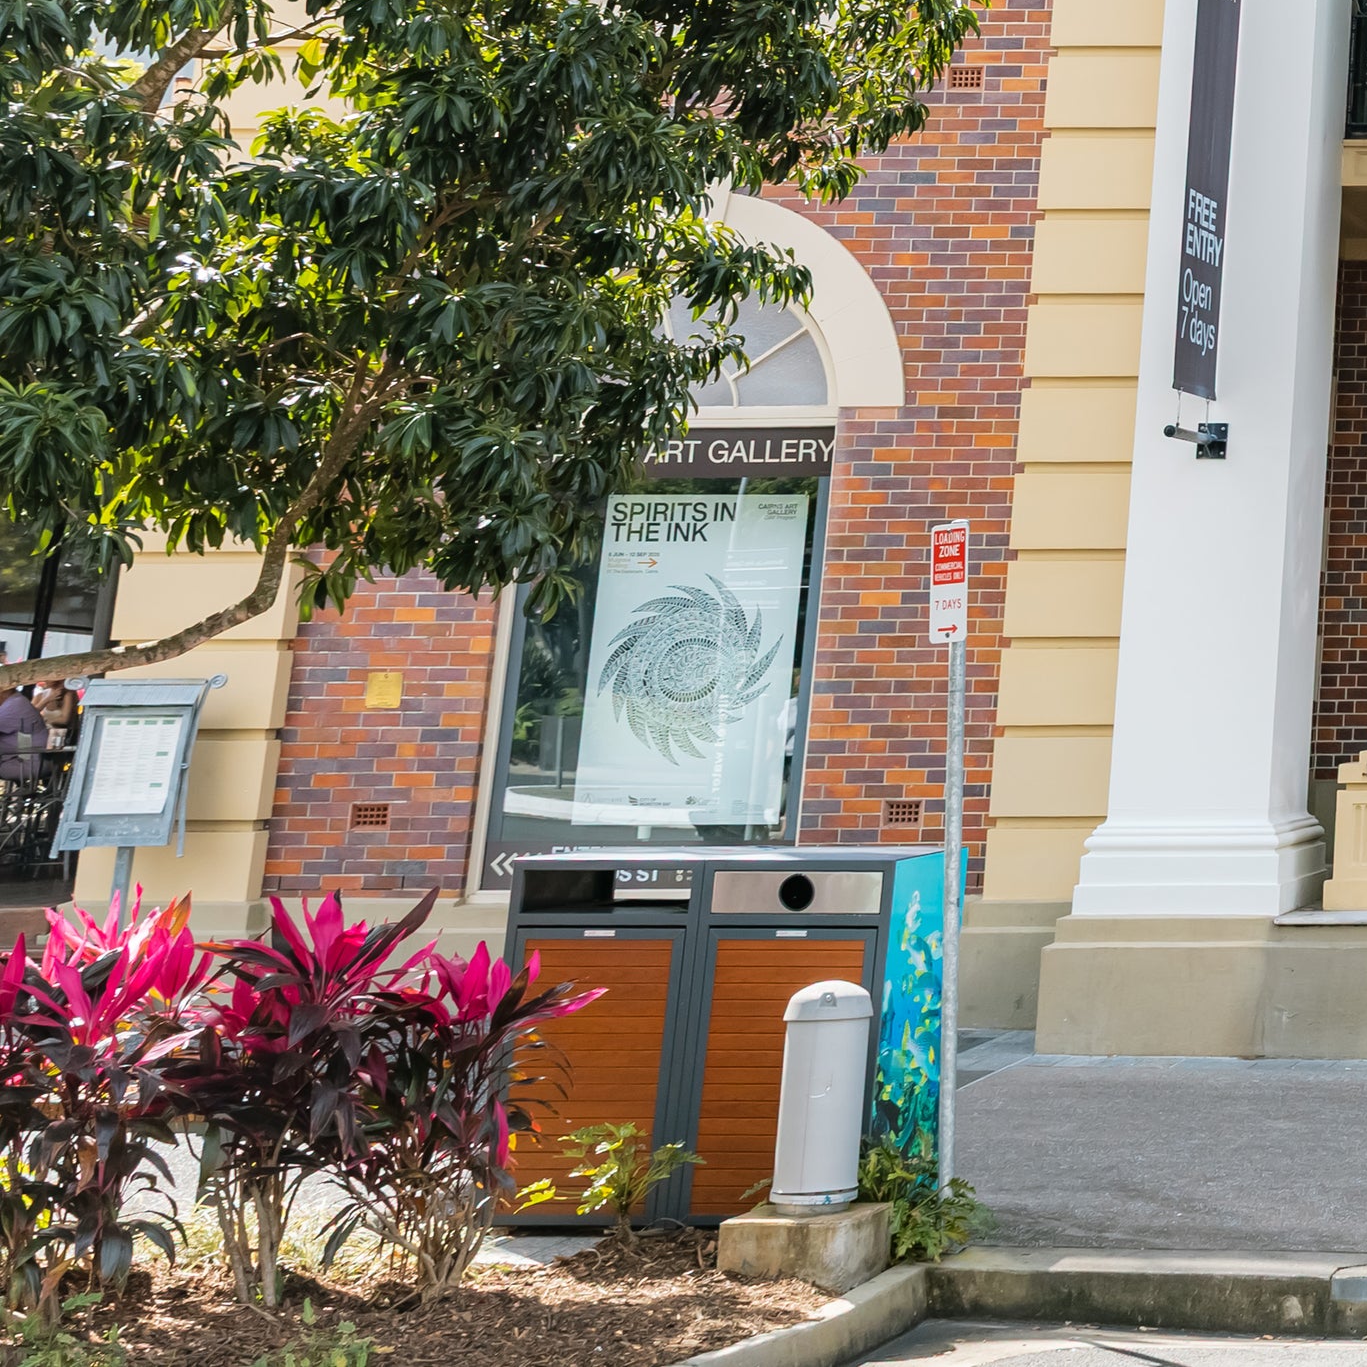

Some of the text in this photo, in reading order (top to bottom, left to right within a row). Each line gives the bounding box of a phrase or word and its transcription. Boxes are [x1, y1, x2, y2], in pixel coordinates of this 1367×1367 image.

[1188, 188, 1218, 232] FREE
[1185, 222, 1223, 267] ENTRY
[1183, 268, 1212, 313] Open
[1180, 306, 1216, 356] 7 days
[644, 439, 835, 463] ART GALLERY
[612, 503, 737, 522] SPIRITS IN
[611, 523, 709, 542] THE INK
[935, 531, 965, 545] LOADING
[939, 544, 960, 558] ZONE
[935, 599, 962, 610] 7 DAYS
